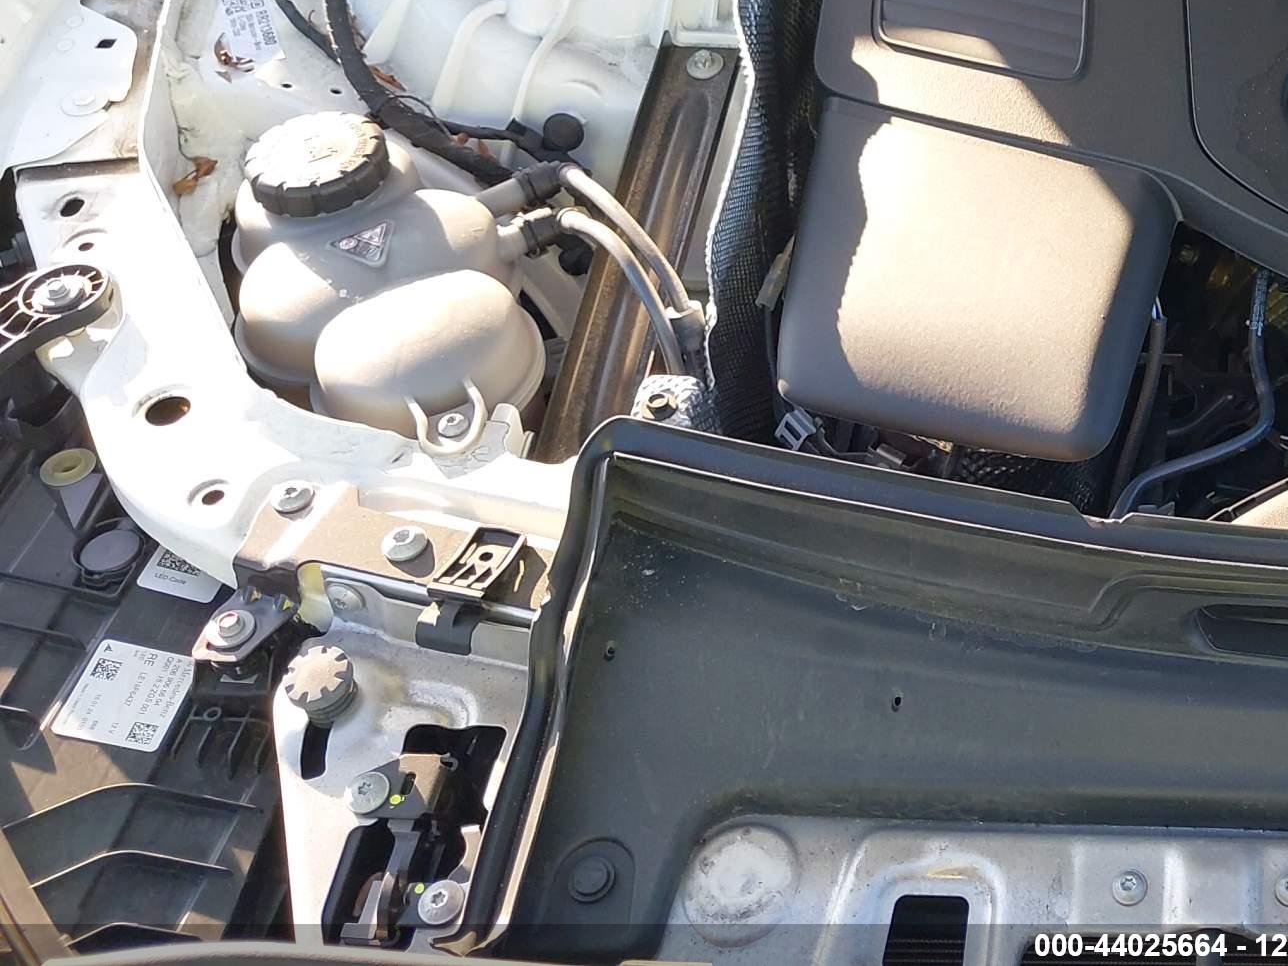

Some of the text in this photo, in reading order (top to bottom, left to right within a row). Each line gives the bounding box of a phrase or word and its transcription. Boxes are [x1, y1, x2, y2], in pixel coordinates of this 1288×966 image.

[154, 572, 187, 585] LED Code
[143, 653, 159, 666] RE
